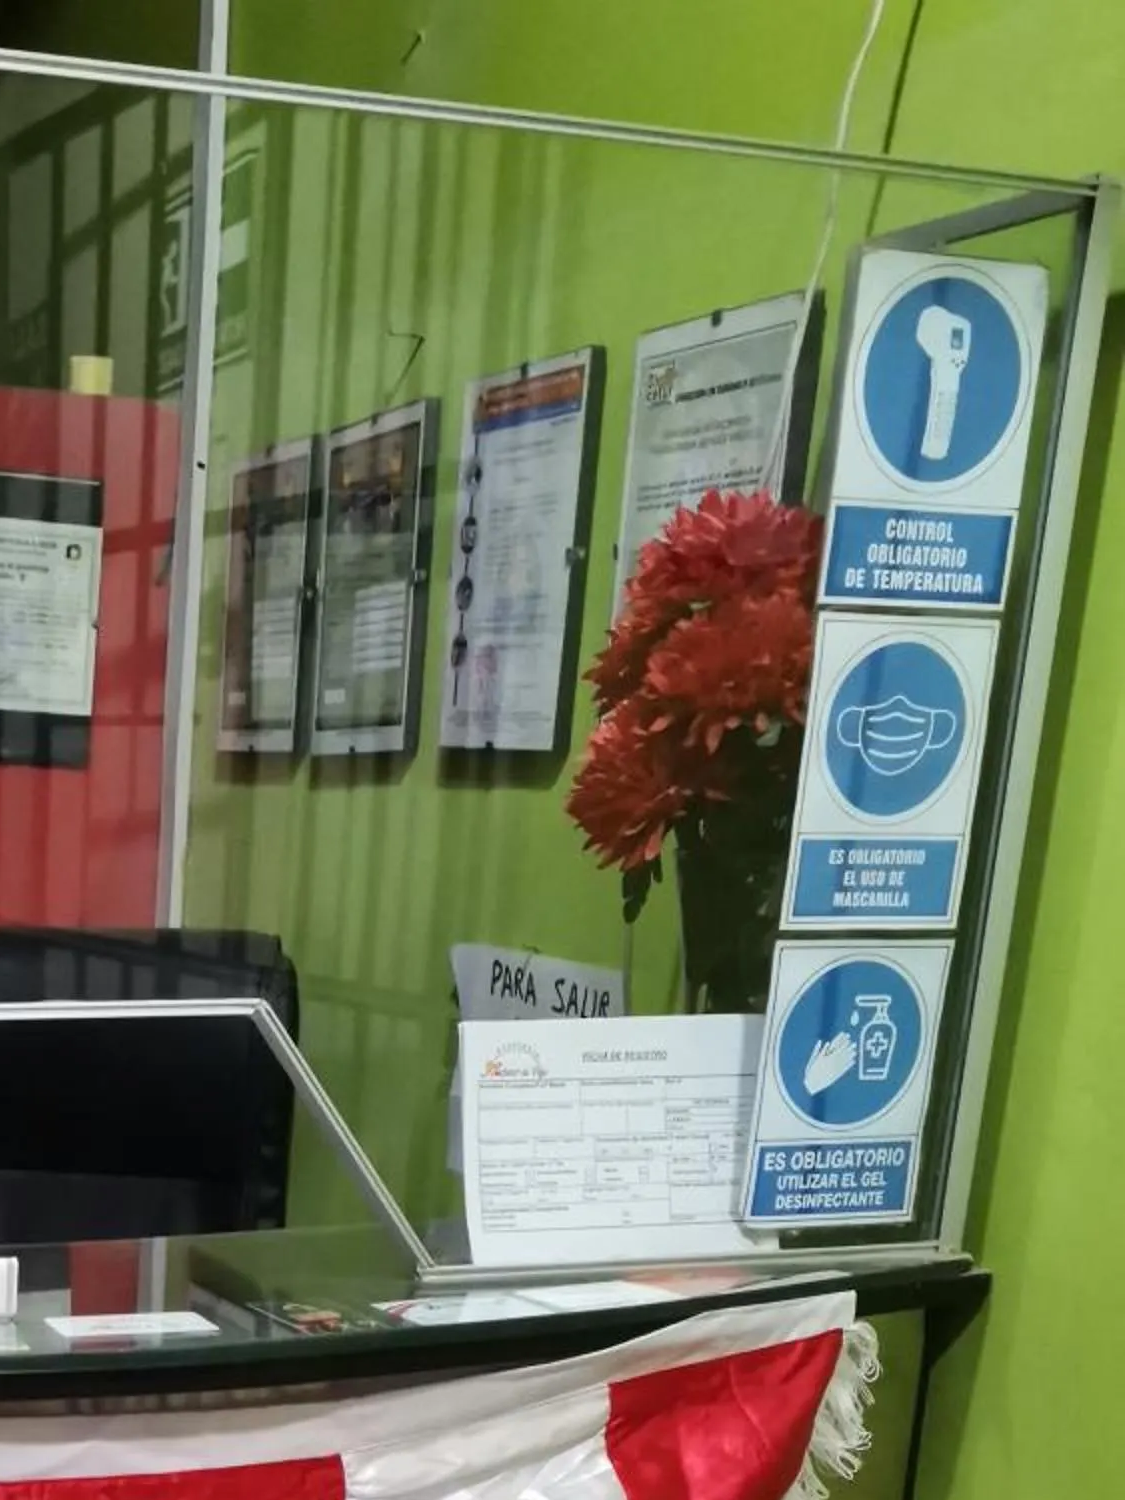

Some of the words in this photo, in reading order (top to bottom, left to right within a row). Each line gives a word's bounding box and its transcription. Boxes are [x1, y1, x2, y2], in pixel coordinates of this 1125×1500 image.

[885, 518, 954, 542] CONTROL
[867, 543, 967, 569] OBLIGATORIO
[844, 568, 865, 589] DE
[871, 569, 983, 594] TEMPERATURA
[828, 849, 847, 865] ES
[848, 849, 926, 866] OBLIGATORIO
[842, 870, 856, 886] EL
[860, 871, 886, 887] USO
[888, 871, 906, 887] DE
[832, 891, 910, 908] MASCARILLA
[490, 960, 537, 1006] PARA
[551, 978, 610, 1018] SALIR
[764, 1152, 787, 1171] ES
[791, 1147, 905, 1171] OBLIGATORIO
[777, 1173, 839, 1190] UTILIZAR
[841, 1173, 857, 1187] EL
[860, 1171, 887, 1187] GEL
[775, 1191, 884, 1210] DESINFECTANTE
